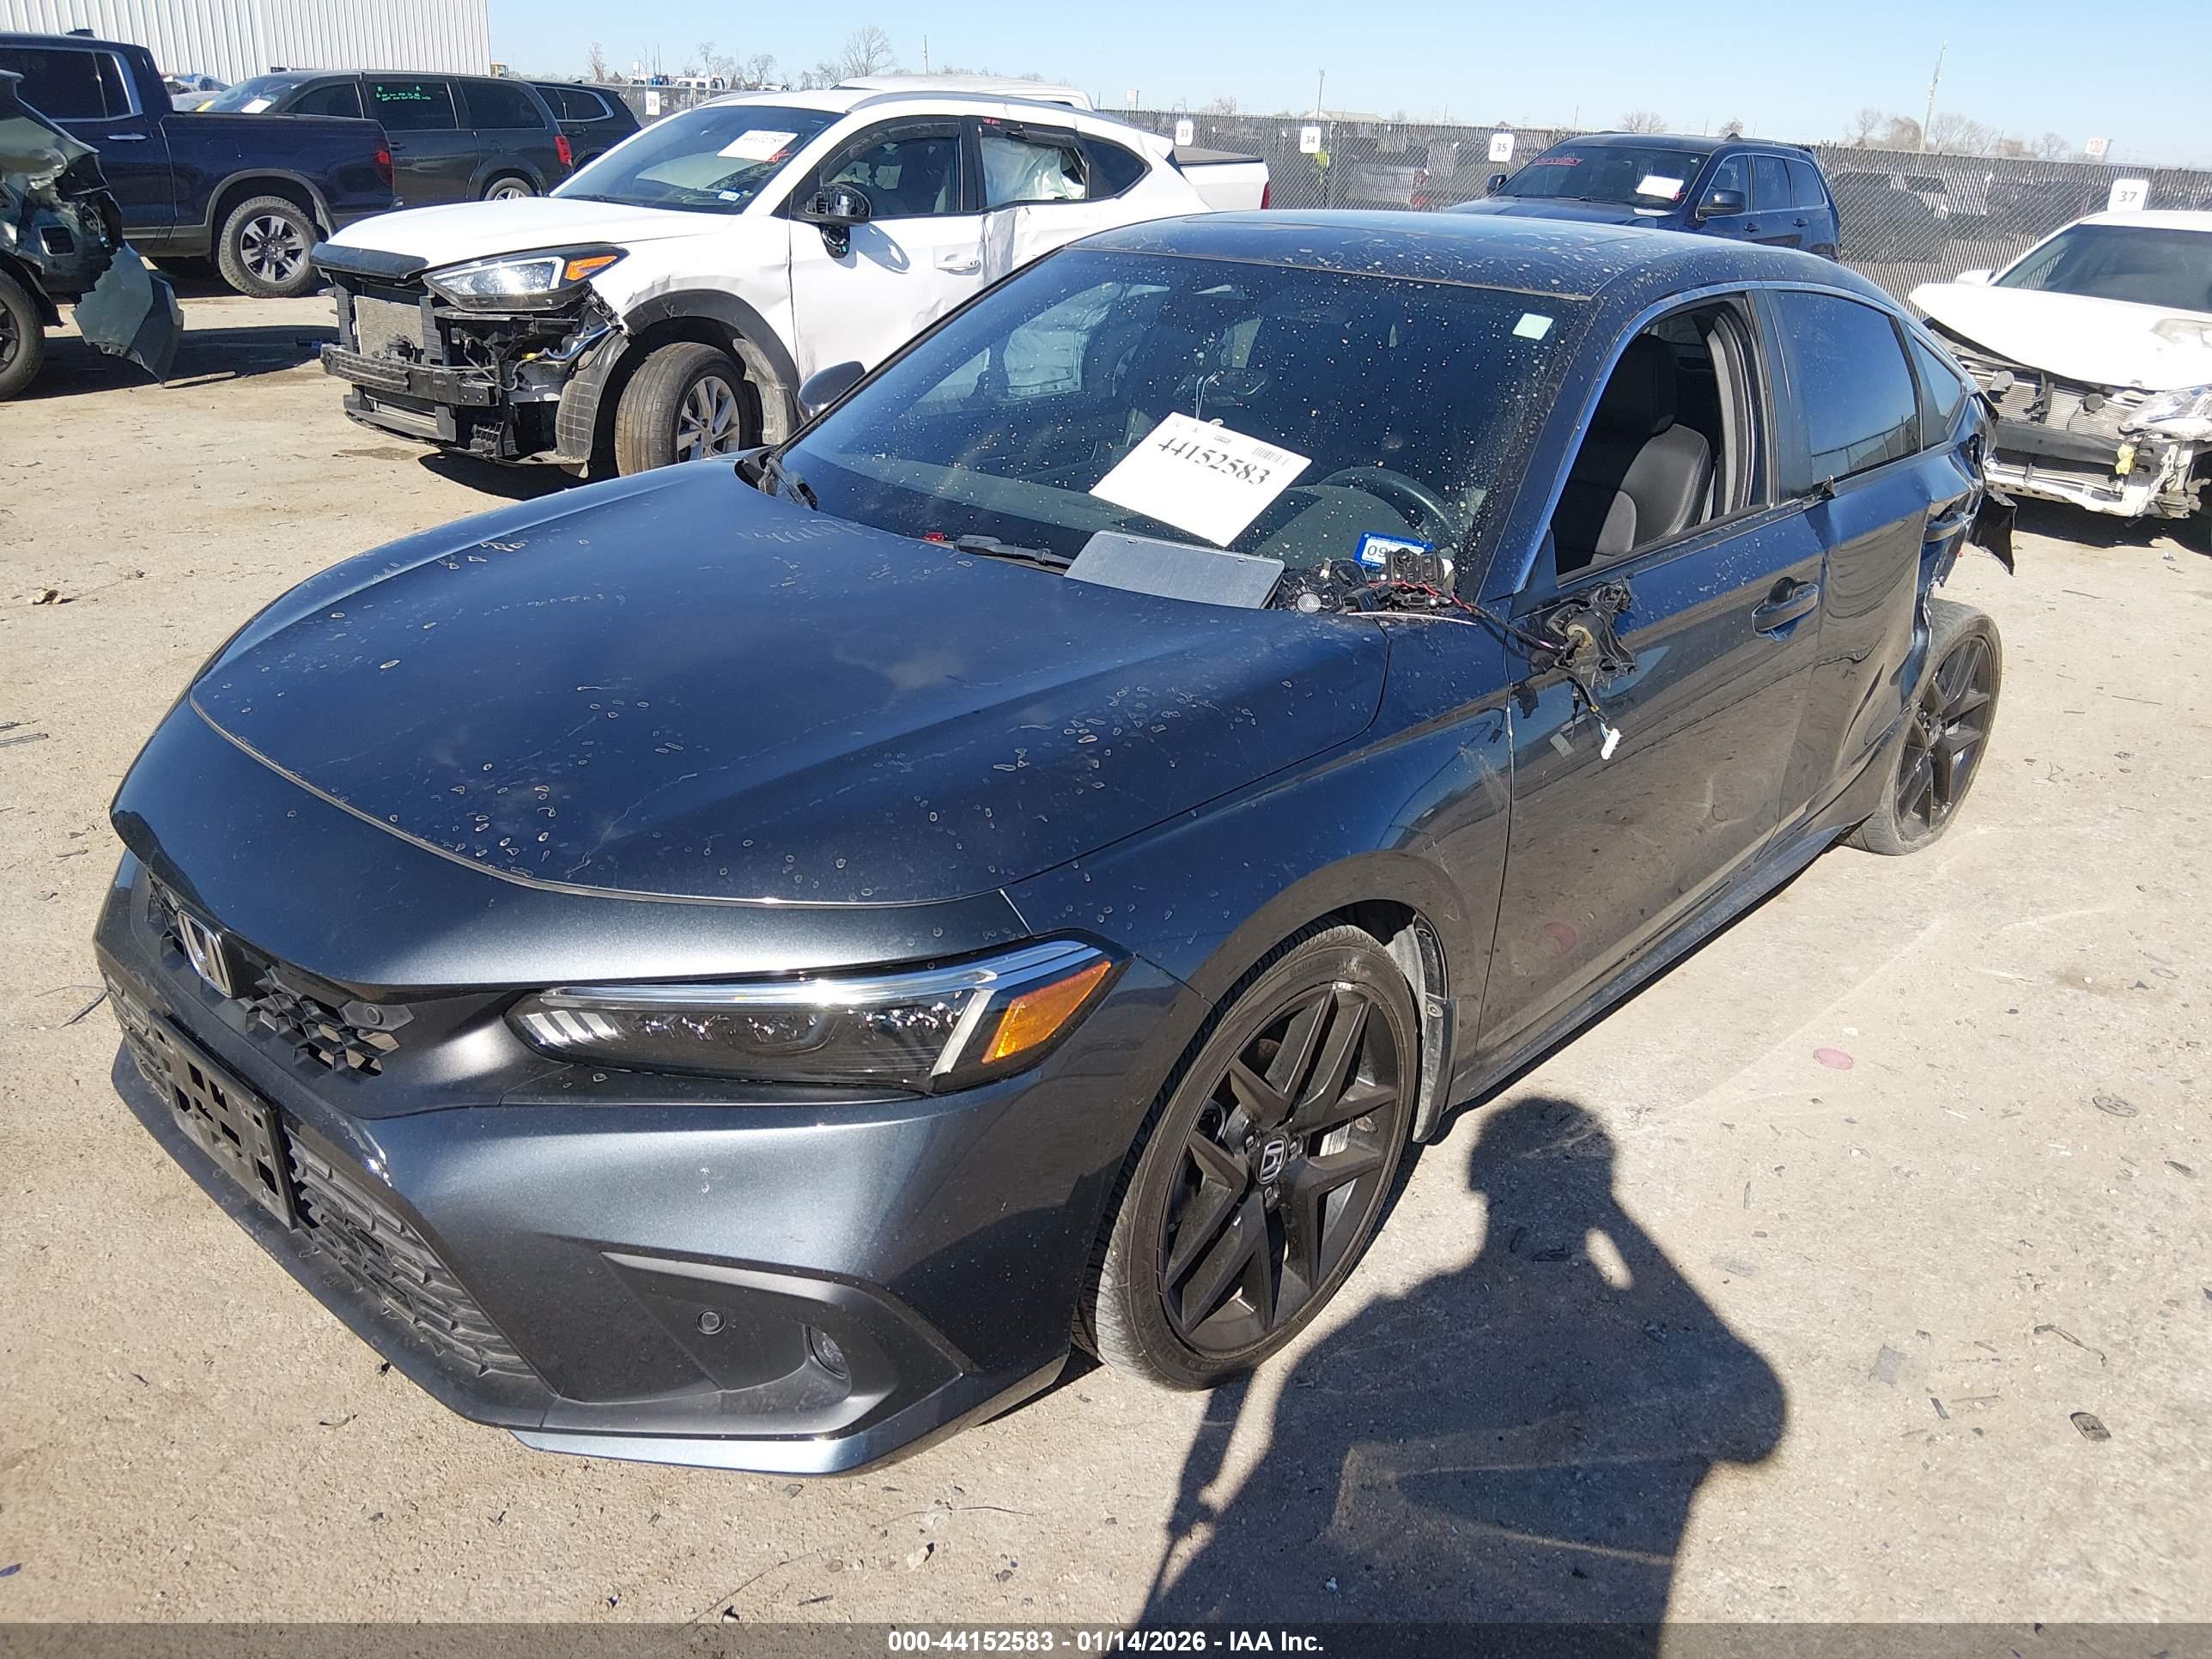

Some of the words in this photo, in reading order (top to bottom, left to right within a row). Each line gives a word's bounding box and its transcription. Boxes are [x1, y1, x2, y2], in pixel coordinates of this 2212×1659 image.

[1305, 135, 1316, 144] 34
[1495, 143, 1508, 152] 35
[2117, 191, 2138, 203] 37
[1158, 437, 1271, 485] 44152583
